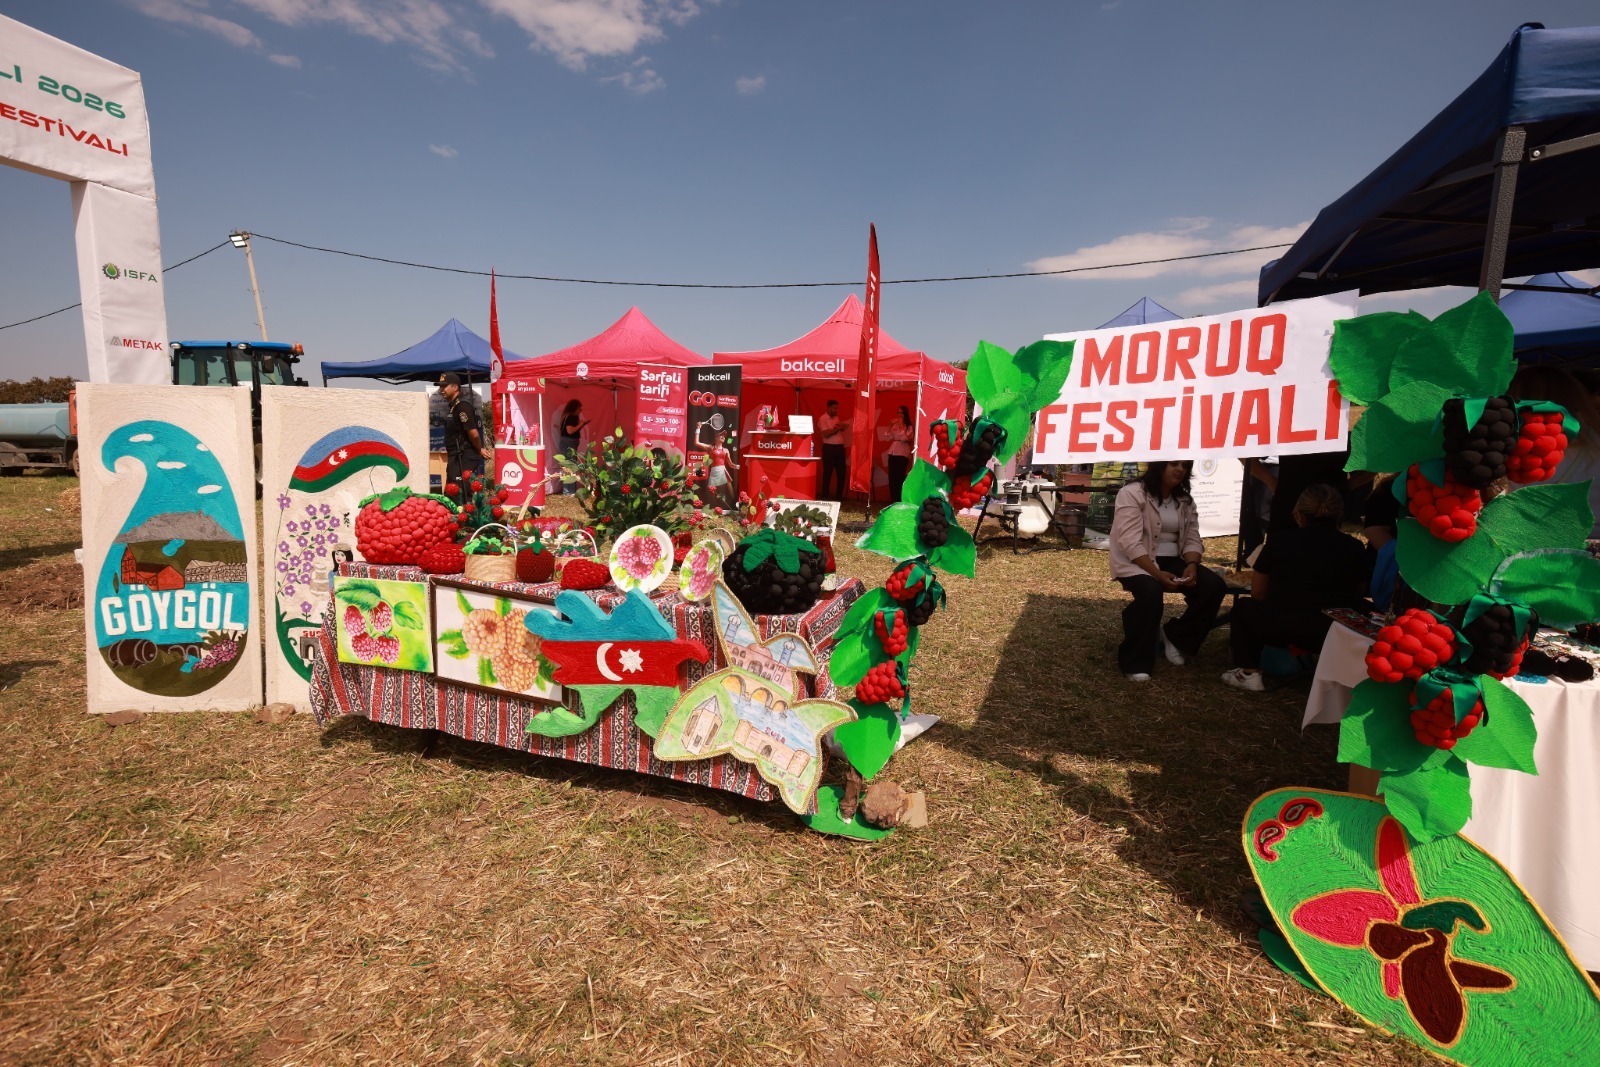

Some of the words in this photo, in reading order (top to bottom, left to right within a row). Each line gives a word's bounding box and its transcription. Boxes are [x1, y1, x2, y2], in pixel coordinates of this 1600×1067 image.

[38, 75, 126, 119] 2026
[123, 268, 158, 283] ISFA
[122, 338, 162, 351] METAK
[1080, 313, 1287, 388] MORUQ
[780, 358, 845, 373] bakcell
[640, 369, 682, 385] Sərfəli
[698, 372, 731, 381] bakcell
[640, 383, 670, 398] tarifi
[689, 390, 716, 408] GO
[1036, 379, 1342, 454] FESTİVALI
[758, 440, 793, 450] bakcell
[503, 469, 522, 479] nar
[100, 582, 245, 636] GÖYGÖL
